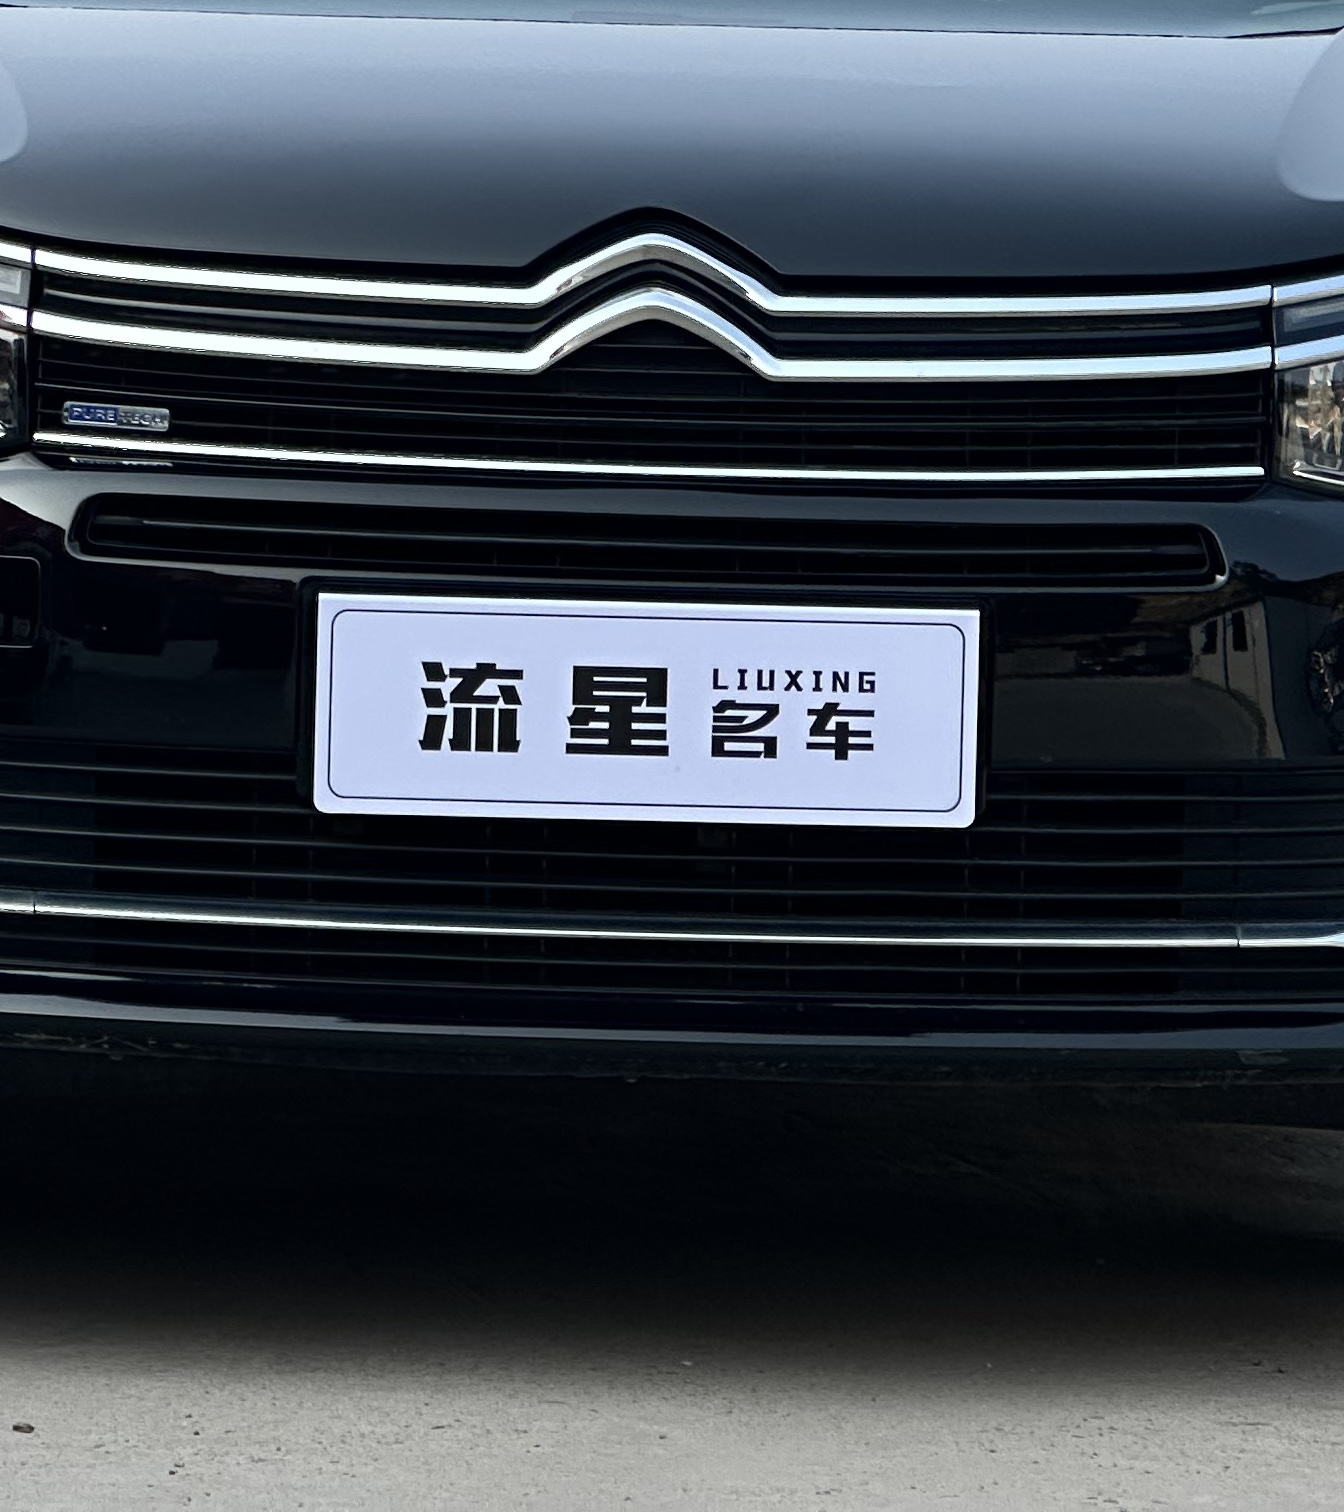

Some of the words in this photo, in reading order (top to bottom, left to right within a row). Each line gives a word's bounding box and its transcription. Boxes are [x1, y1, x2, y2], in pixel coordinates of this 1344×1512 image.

[418, 661, 875, 761] 流星名车
[712, 668, 876, 694] LIUXING
